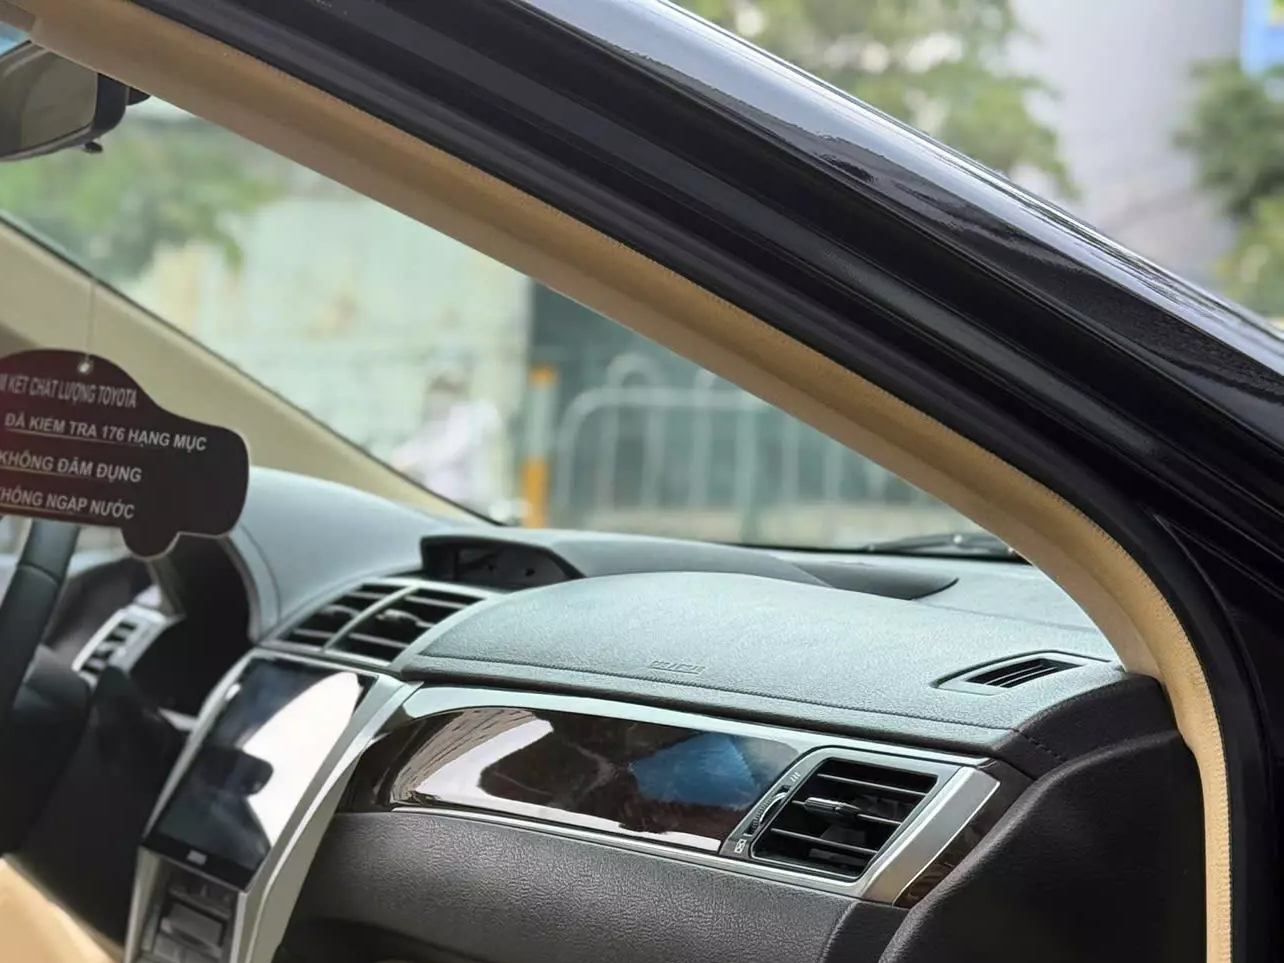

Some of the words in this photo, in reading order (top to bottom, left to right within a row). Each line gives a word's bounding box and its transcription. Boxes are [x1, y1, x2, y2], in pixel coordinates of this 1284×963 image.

[97, 384, 138, 408] TOYOTA
[68, 421, 98, 437] TRA
[102, 426, 125, 441] 176
[128, 429, 171, 447] HẠNG
[172, 435, 208, 454] MỤC
[96, 463, 144, 483] ĐỤNG
[89, 499, 136, 519] NƯỚC
